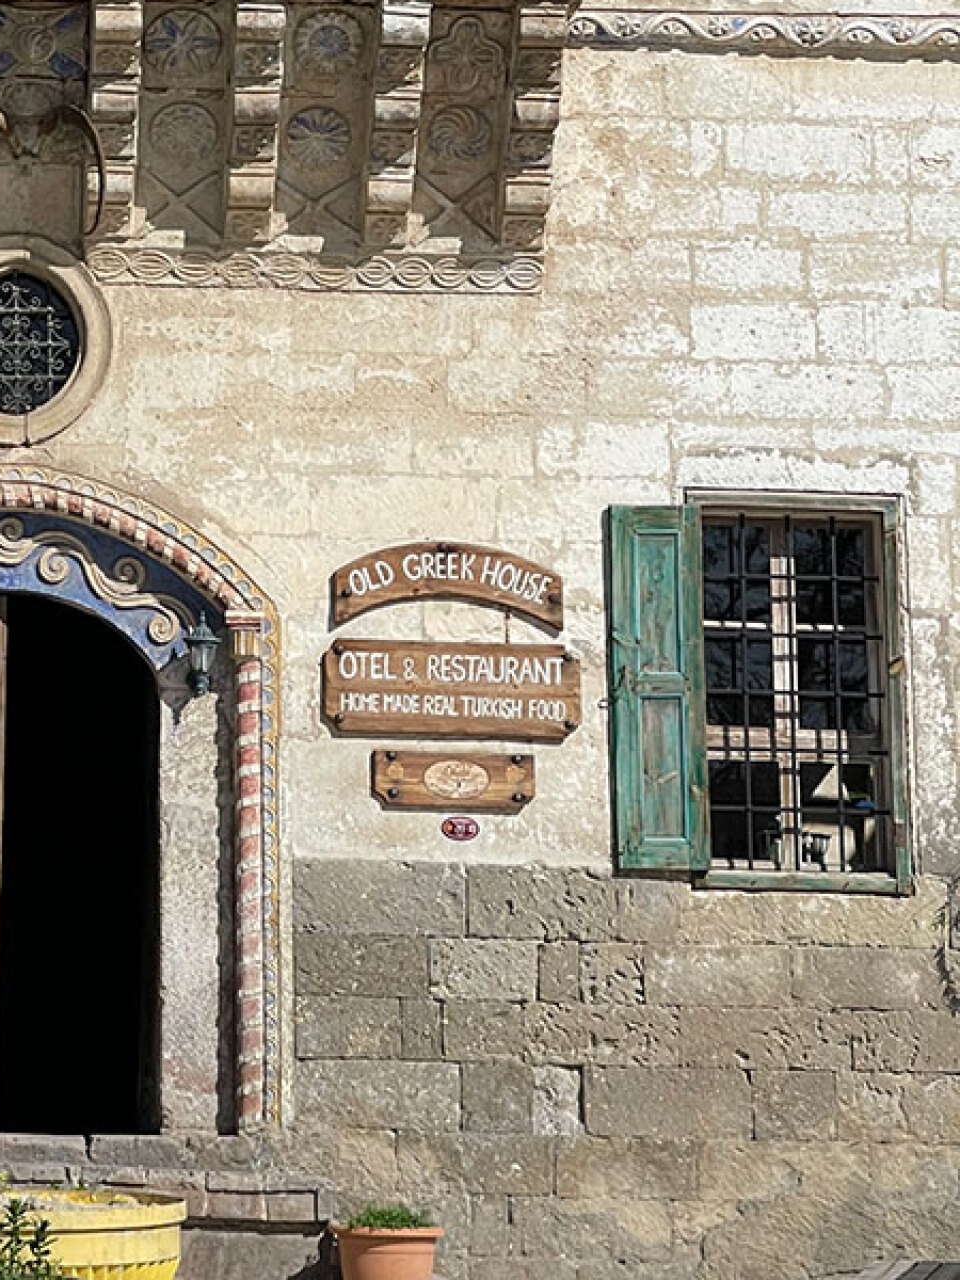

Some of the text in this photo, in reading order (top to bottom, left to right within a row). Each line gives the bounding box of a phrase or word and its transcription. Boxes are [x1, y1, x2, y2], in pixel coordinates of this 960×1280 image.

[349, 552, 553, 605] OLD GREEK HOUSE
[339, 651, 563, 685] OTEL & RESTAURANT
[340, 692, 566, 721] HOME MADE REAL TURKISH FOOD
